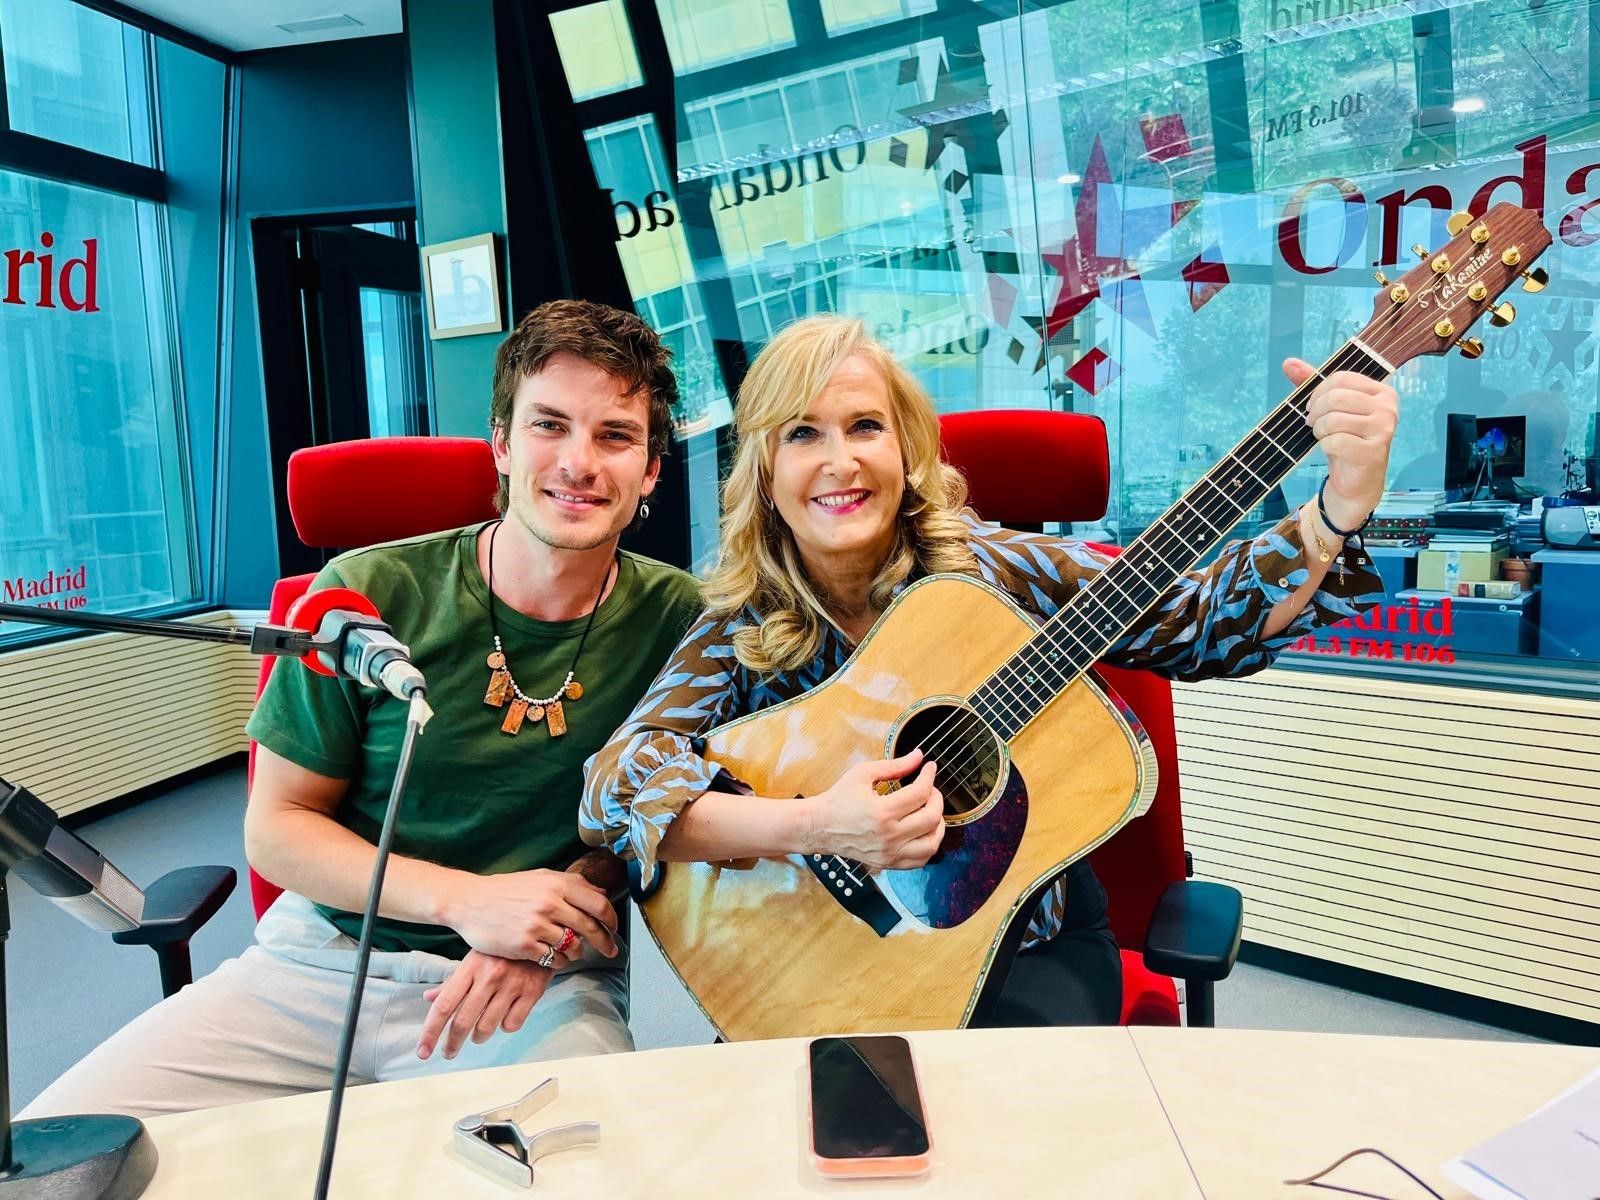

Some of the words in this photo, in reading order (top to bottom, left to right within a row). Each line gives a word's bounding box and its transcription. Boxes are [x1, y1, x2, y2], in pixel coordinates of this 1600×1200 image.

[3, 564, 86, 604] Madrid
[64, 595, 87, 610] 106
[1330, 596, 1454, 637] drid
[1349, 637, 1395, 661] FM
[1403, 642, 1457, 666] 106
